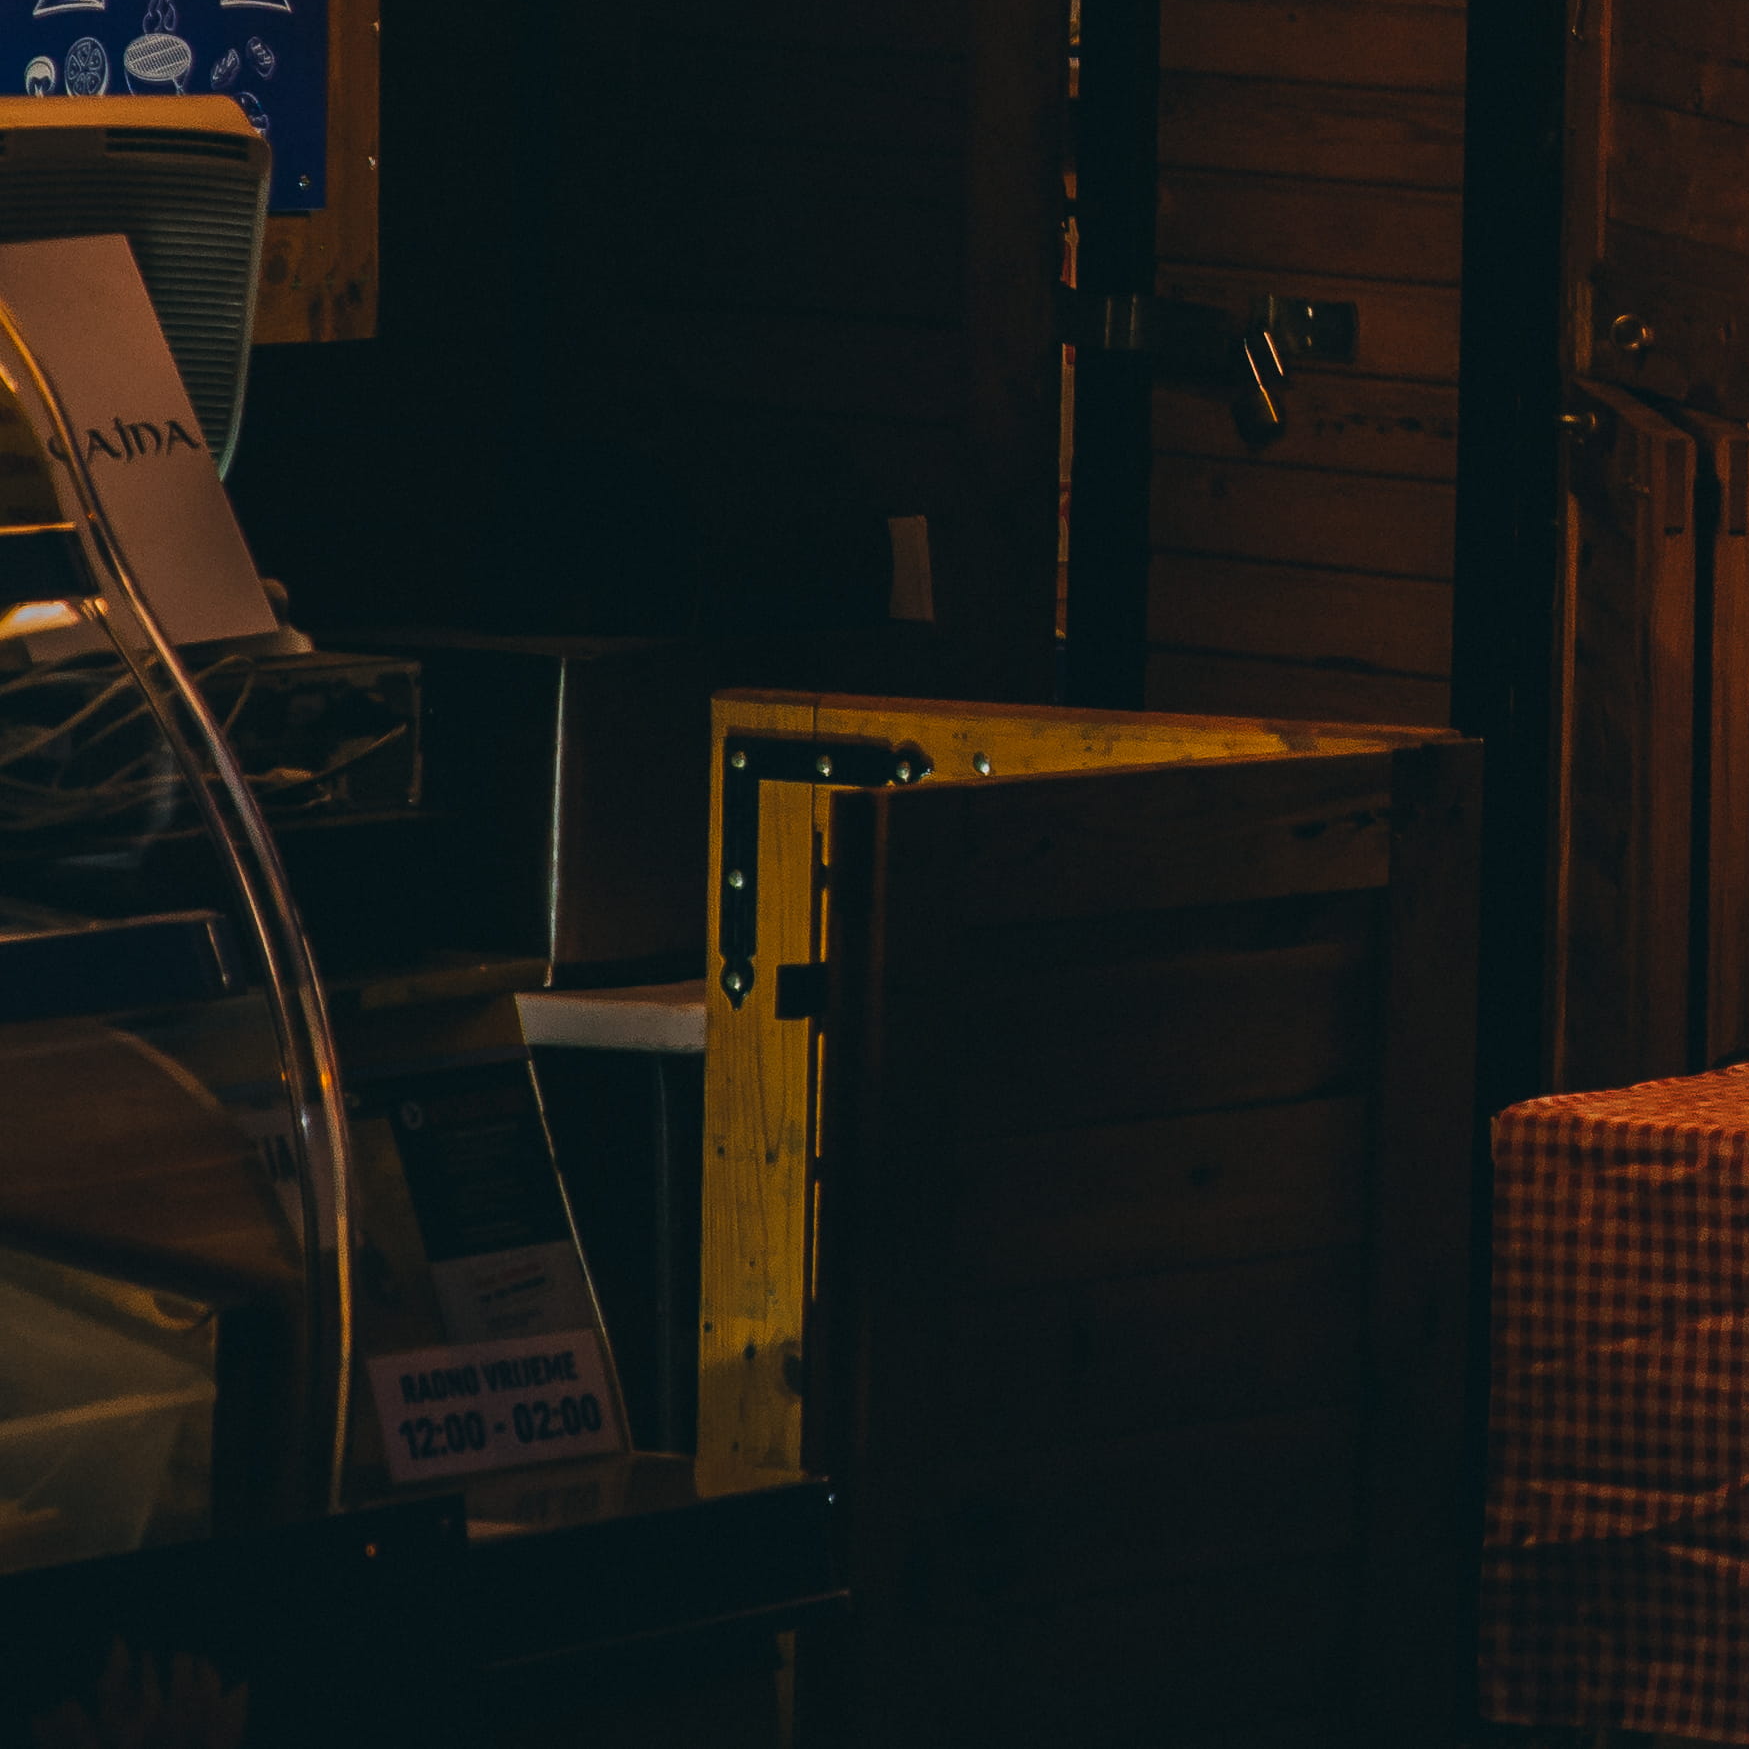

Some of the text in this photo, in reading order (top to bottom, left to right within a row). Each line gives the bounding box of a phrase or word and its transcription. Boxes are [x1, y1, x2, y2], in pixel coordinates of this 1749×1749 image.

[400, 1350, 579, 1405] RADNO VRIJEME
[399, 1410, 488, 1461] 12:00
[512, 1393, 603, 1446] 02:00
